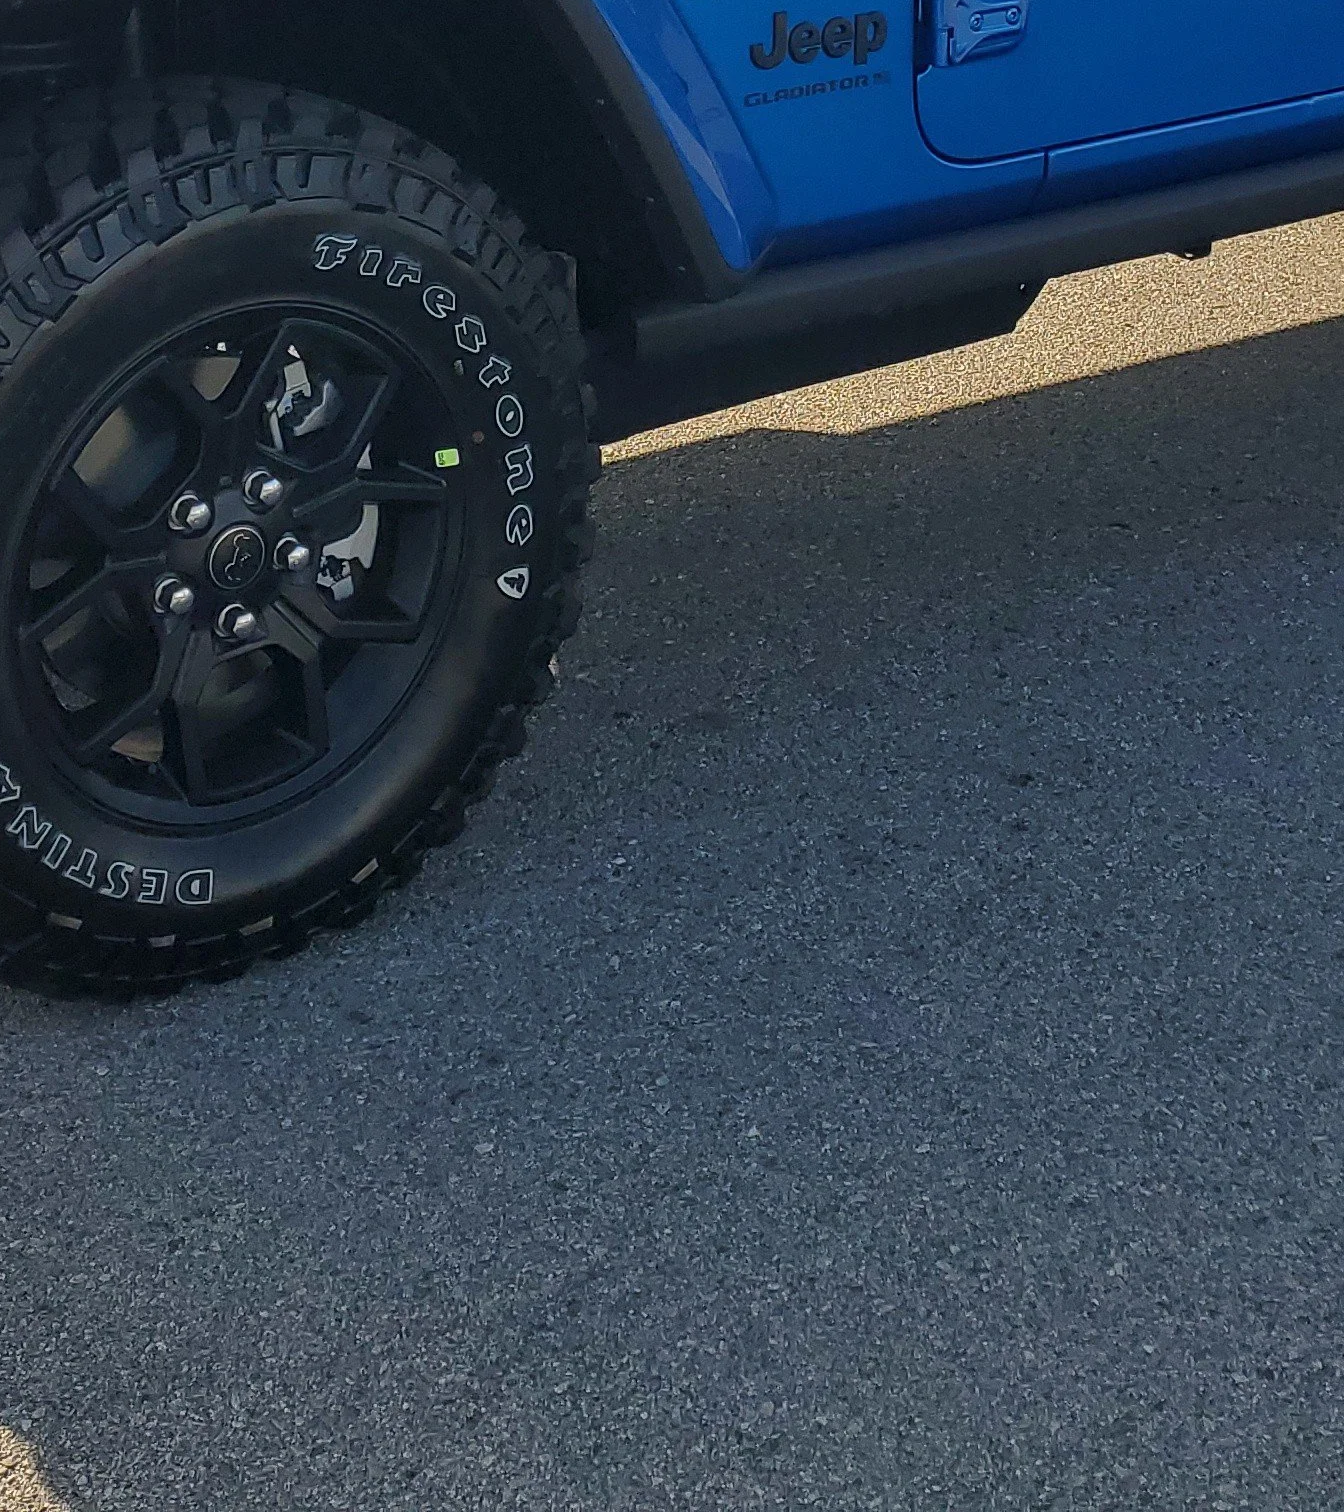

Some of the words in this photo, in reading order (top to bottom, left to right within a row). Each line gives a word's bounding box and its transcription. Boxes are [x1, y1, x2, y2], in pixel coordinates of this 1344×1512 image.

[749, 11, 888, 70] Jeep
[743, 74, 869, 107] GLADIATOR
[315, 234, 533, 546] Firestone
